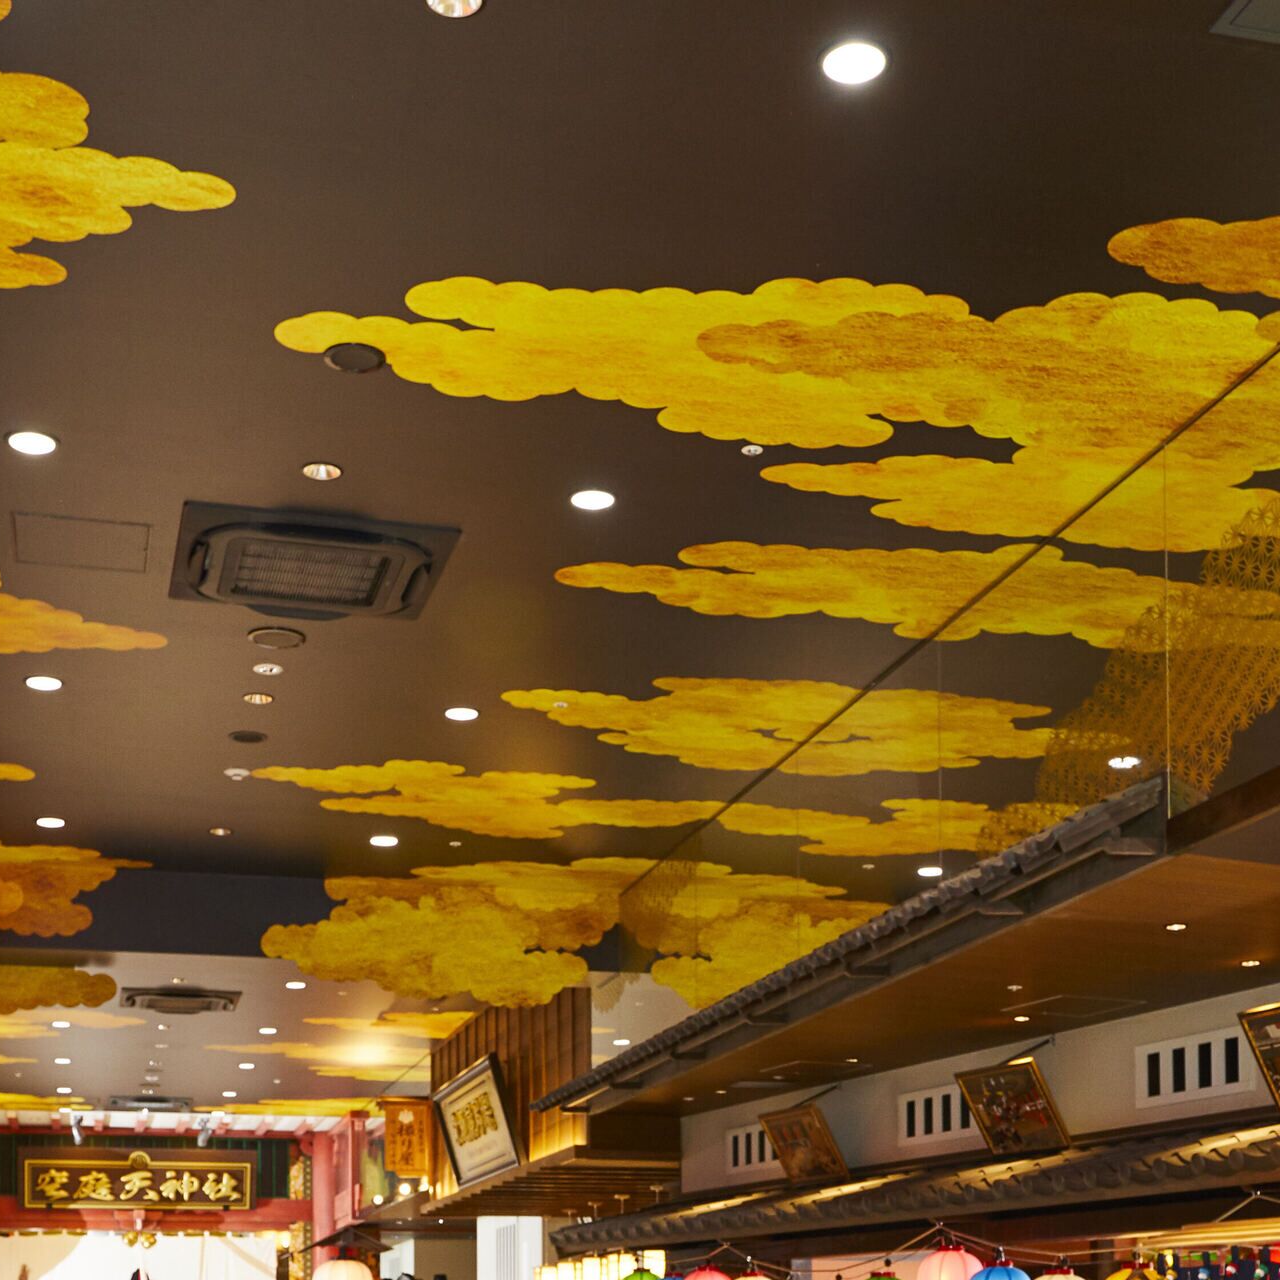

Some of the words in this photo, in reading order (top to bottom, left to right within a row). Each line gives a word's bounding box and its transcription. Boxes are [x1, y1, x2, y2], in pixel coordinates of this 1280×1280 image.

[35, 1168, 242, 1202] 空庭天神社
